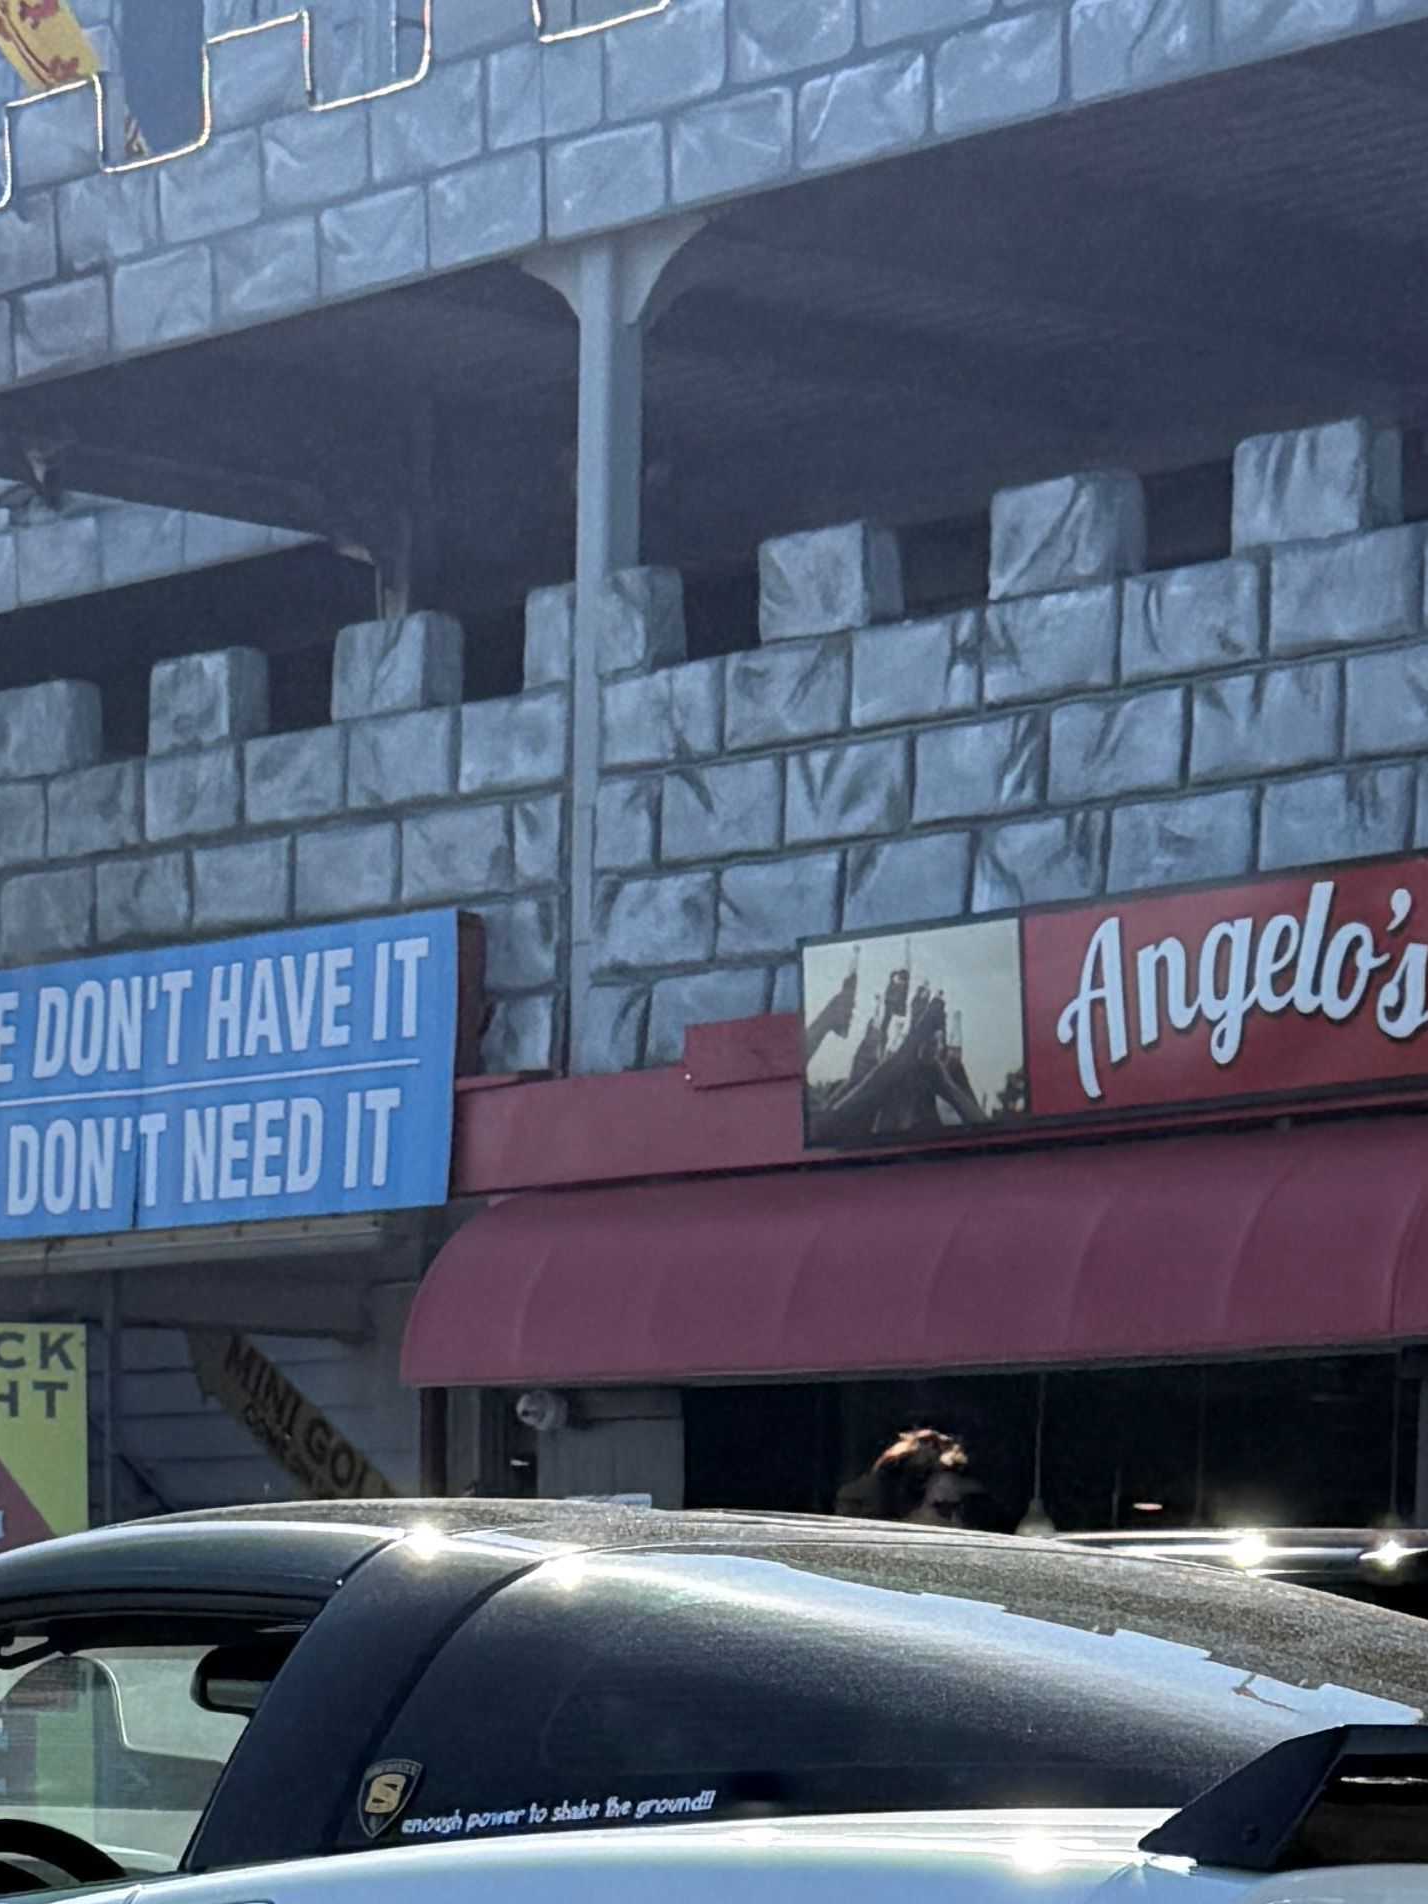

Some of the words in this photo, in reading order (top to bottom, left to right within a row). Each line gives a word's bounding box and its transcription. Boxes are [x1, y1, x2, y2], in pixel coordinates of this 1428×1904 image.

[31, 968, 193, 1081] DON'T
[205, 946, 354, 1061] HAVE
[371, 936, 430, 1043] IT
[6, 1112, 167, 1217] DON'T
[181, 1097, 325, 1204] NEED
[343, 1086, 401, 1190] IT
[401, 1810, 462, 1834] enough
[465, 1808, 525, 1832] power
[528, 1802, 547, 1824] to
[551, 1799, 600, 1822] shake
[605, 1795, 632, 1818] the
